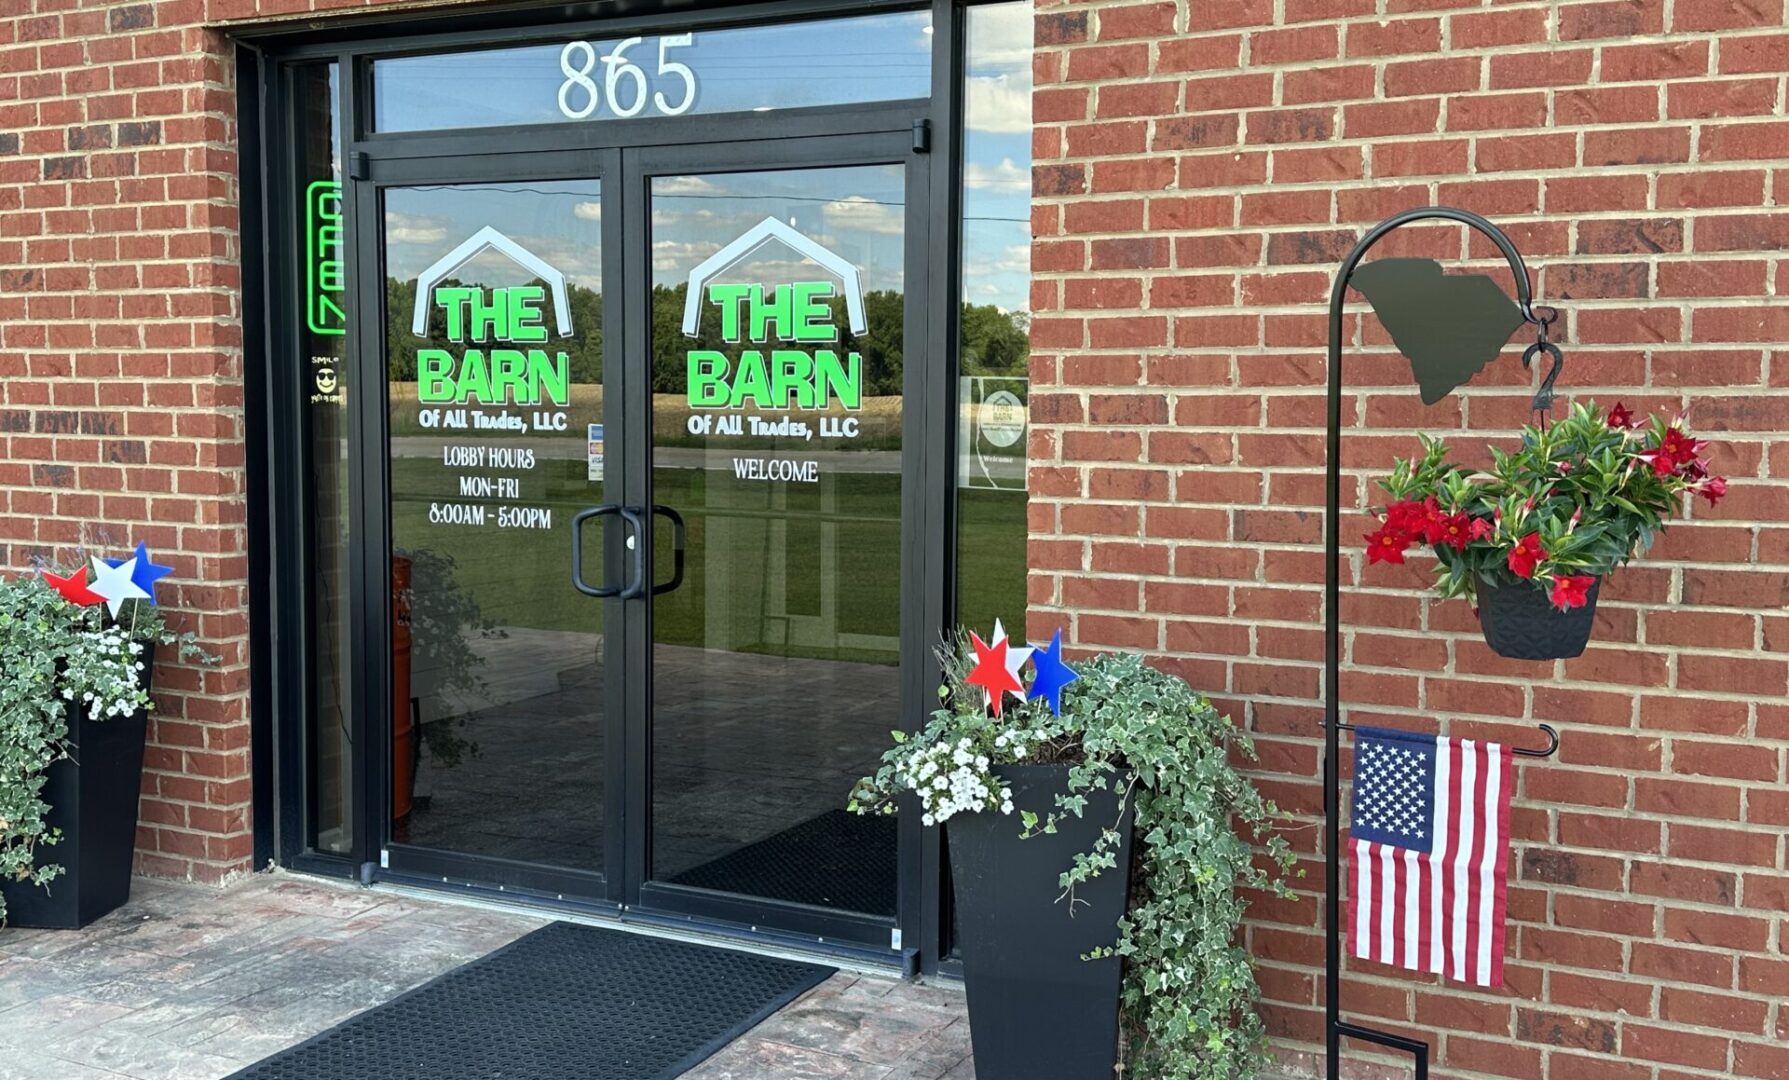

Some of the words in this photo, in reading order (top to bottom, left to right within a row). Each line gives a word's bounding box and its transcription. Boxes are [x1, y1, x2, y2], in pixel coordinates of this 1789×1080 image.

[558, 32, 696, 119] 865
[435, 286, 548, 343] THE
[710, 281, 838, 343] THE
[417, 349, 570, 407] BARN
[687, 350, 863, 412] BARN
[418, 409, 441, 428] Of
[443, 409, 468, 429] All
[533, 412, 568, 431] LLC
[687, 415, 712, 435] Of
[715, 415, 744, 435] All
[819, 417, 859, 438] LLC
[444, 446, 486, 467] LOBBY
[489, 447, 536, 469] HOURS
[733, 458, 819, 482] WELCOME
[460, 476, 519, 498] MON-FRI
[429, 502, 484, 525] 8:00AM
[498, 506, 551, 529] 5:00PM
